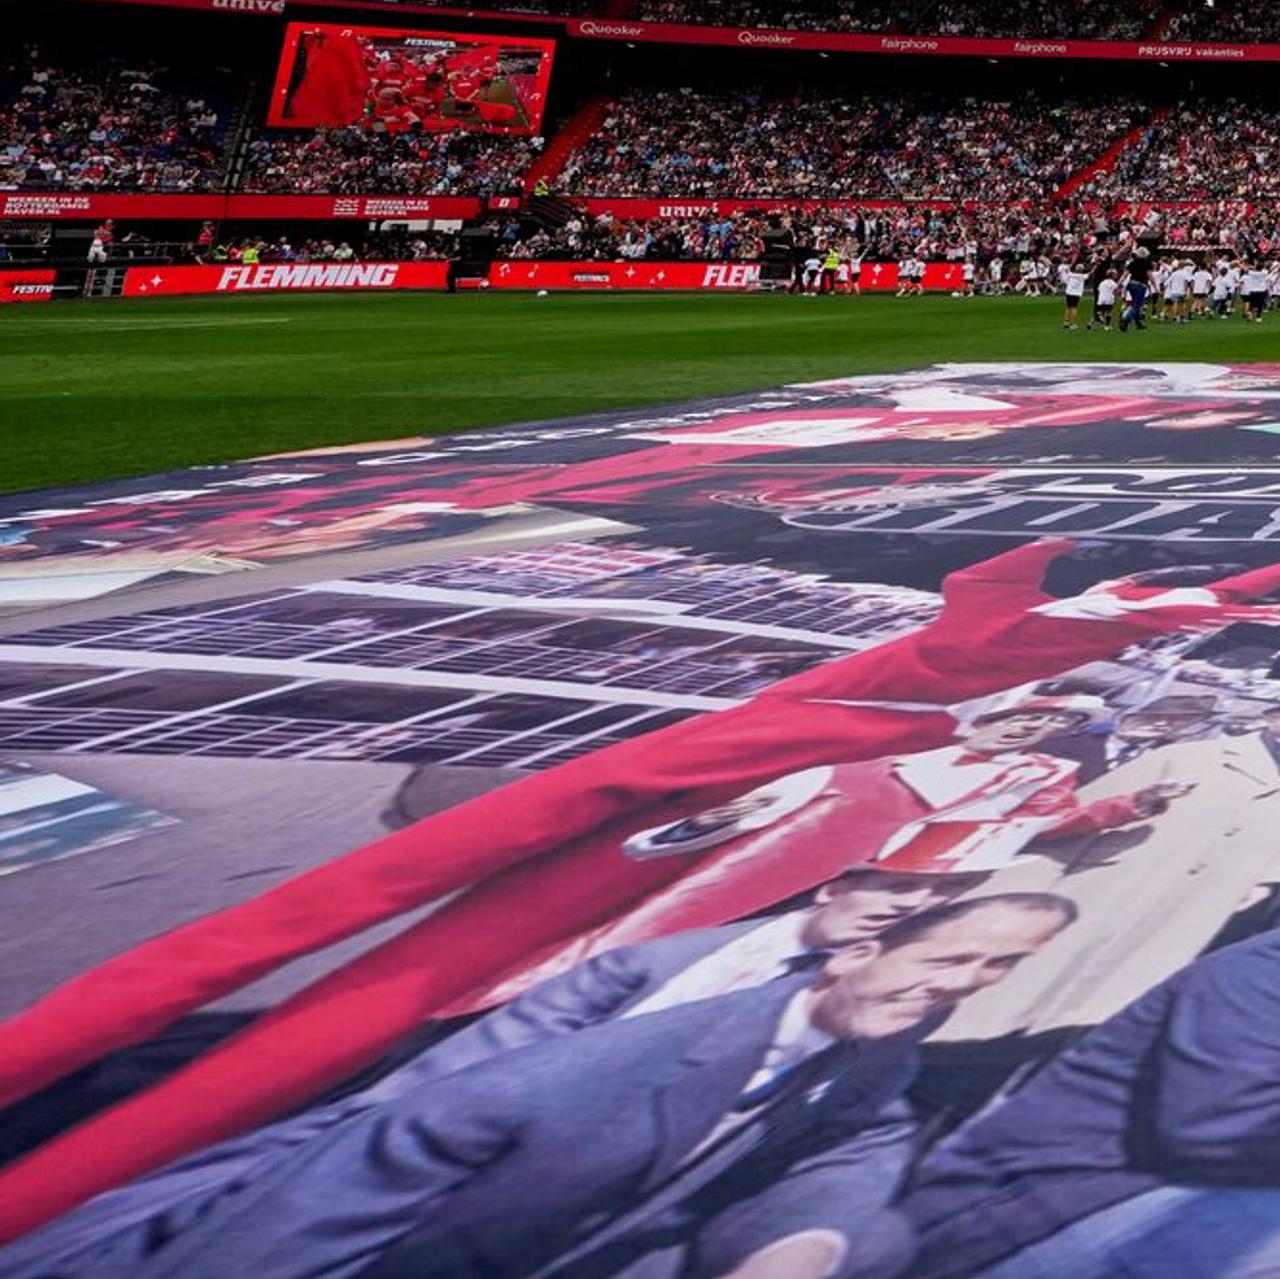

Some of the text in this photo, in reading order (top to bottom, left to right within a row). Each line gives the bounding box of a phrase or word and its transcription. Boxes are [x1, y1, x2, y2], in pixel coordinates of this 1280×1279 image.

[580, 21, 644, 36] Quooker
[737, 31, 795, 45] Quooker
[880, 37, 938, 51] fairphone
[1014, 42, 1067, 54] fairphone
[1196, 47, 1244, 57] vakanties
[216, 264, 399, 290] FLEMMING
